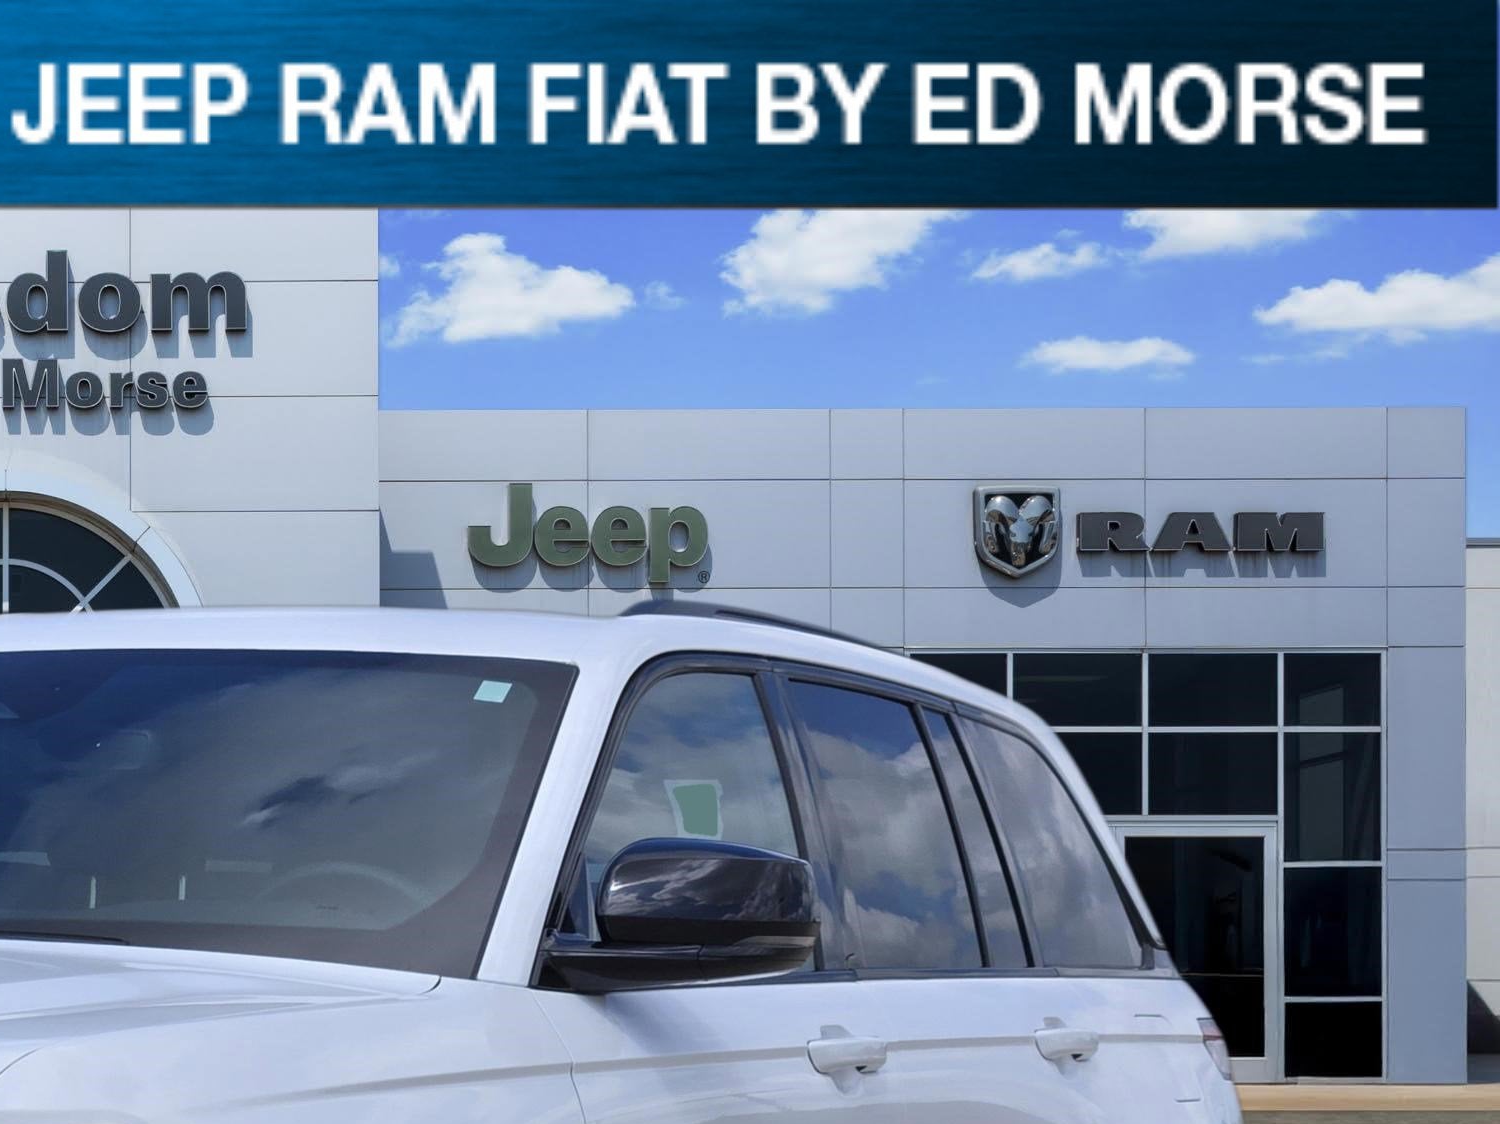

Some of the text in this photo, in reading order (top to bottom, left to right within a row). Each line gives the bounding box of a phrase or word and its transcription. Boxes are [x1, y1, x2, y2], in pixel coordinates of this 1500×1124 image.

[2, 357, 209, 410] Morse
[467, 481, 709, 584] Jeep
[1075, 511, 1327, 555] RAM
